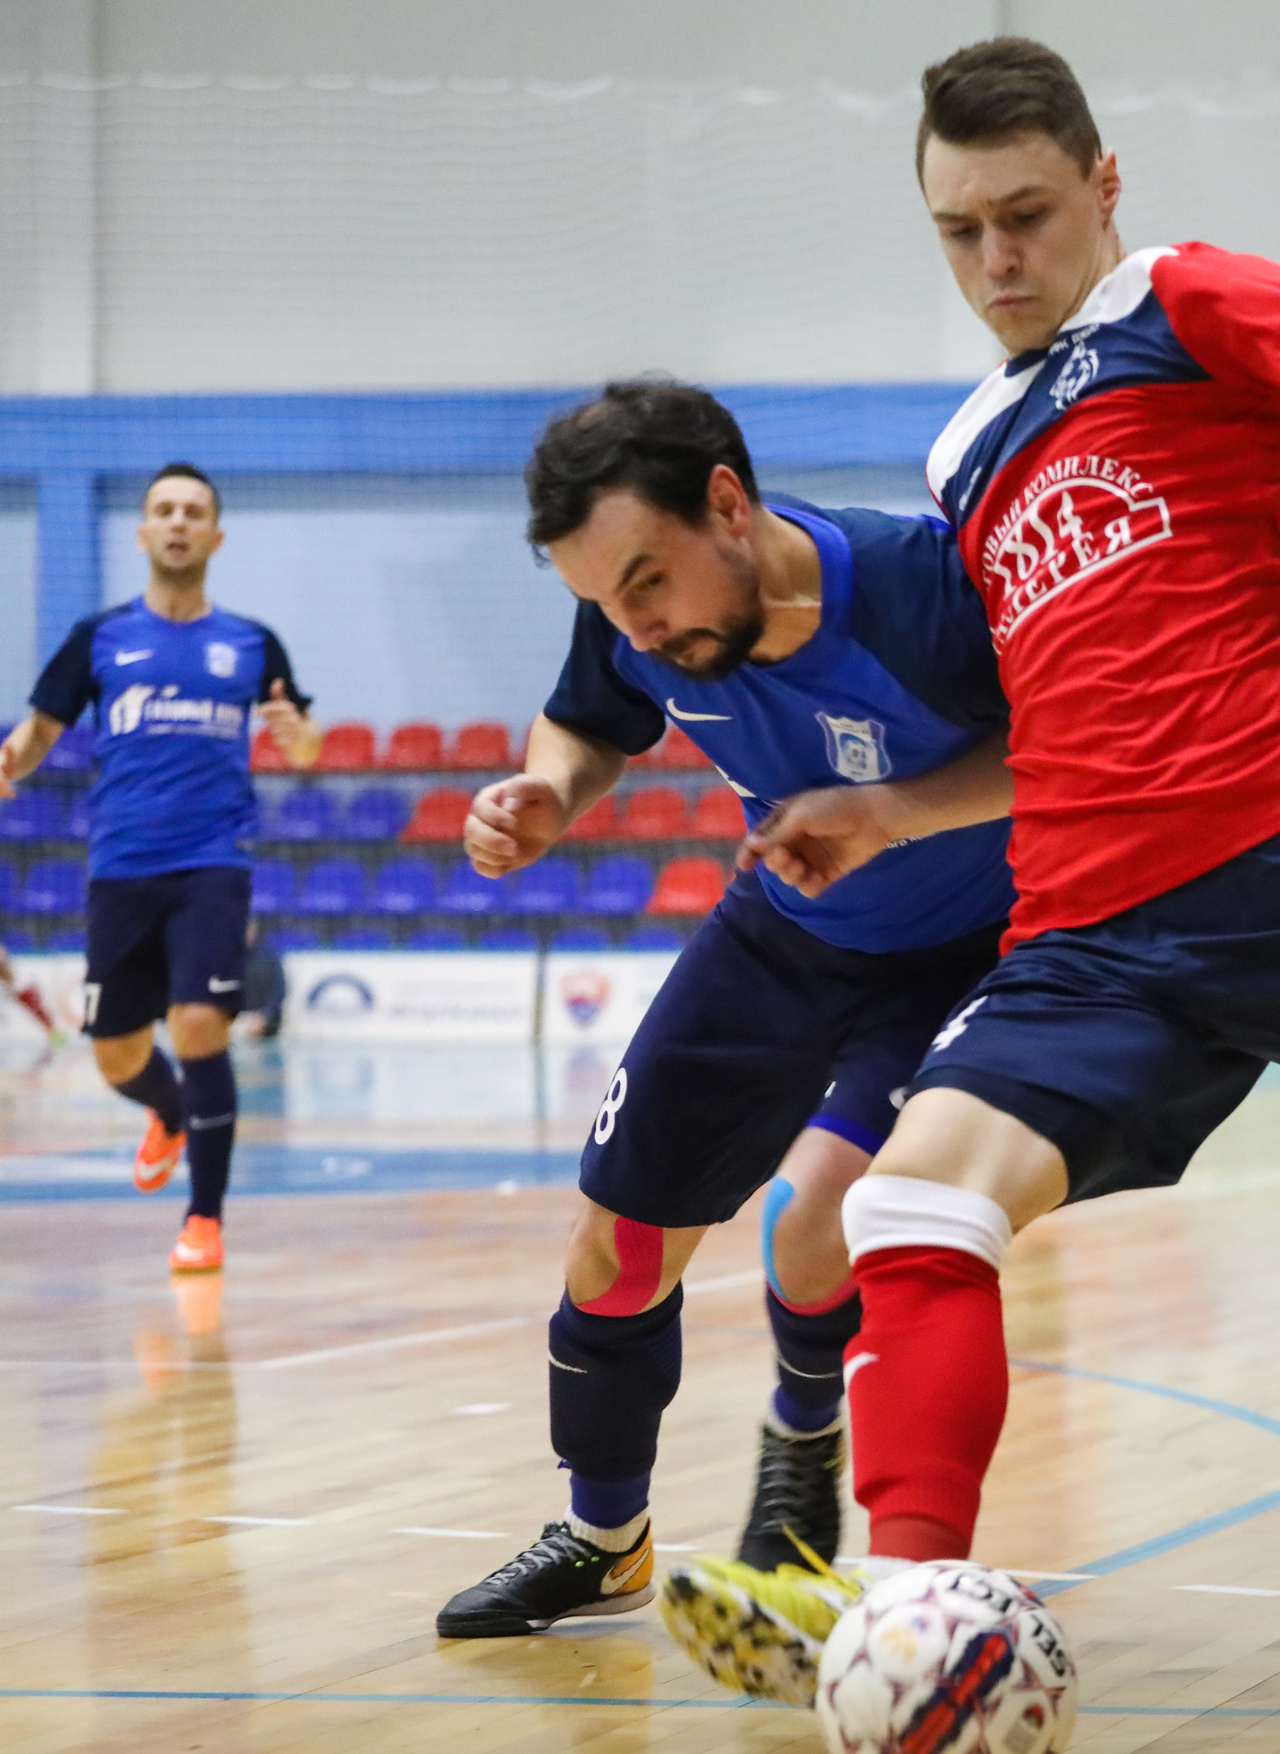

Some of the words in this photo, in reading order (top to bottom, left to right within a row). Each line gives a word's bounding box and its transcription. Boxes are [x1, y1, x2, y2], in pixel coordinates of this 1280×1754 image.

[982, 497, 1023, 586] ГОВЫЙ
[1022, 454, 1154, 506] КОМПЛЕКС
[993, 490, 1083, 600] 1814
[593, 1066, 629, 1146] 8
